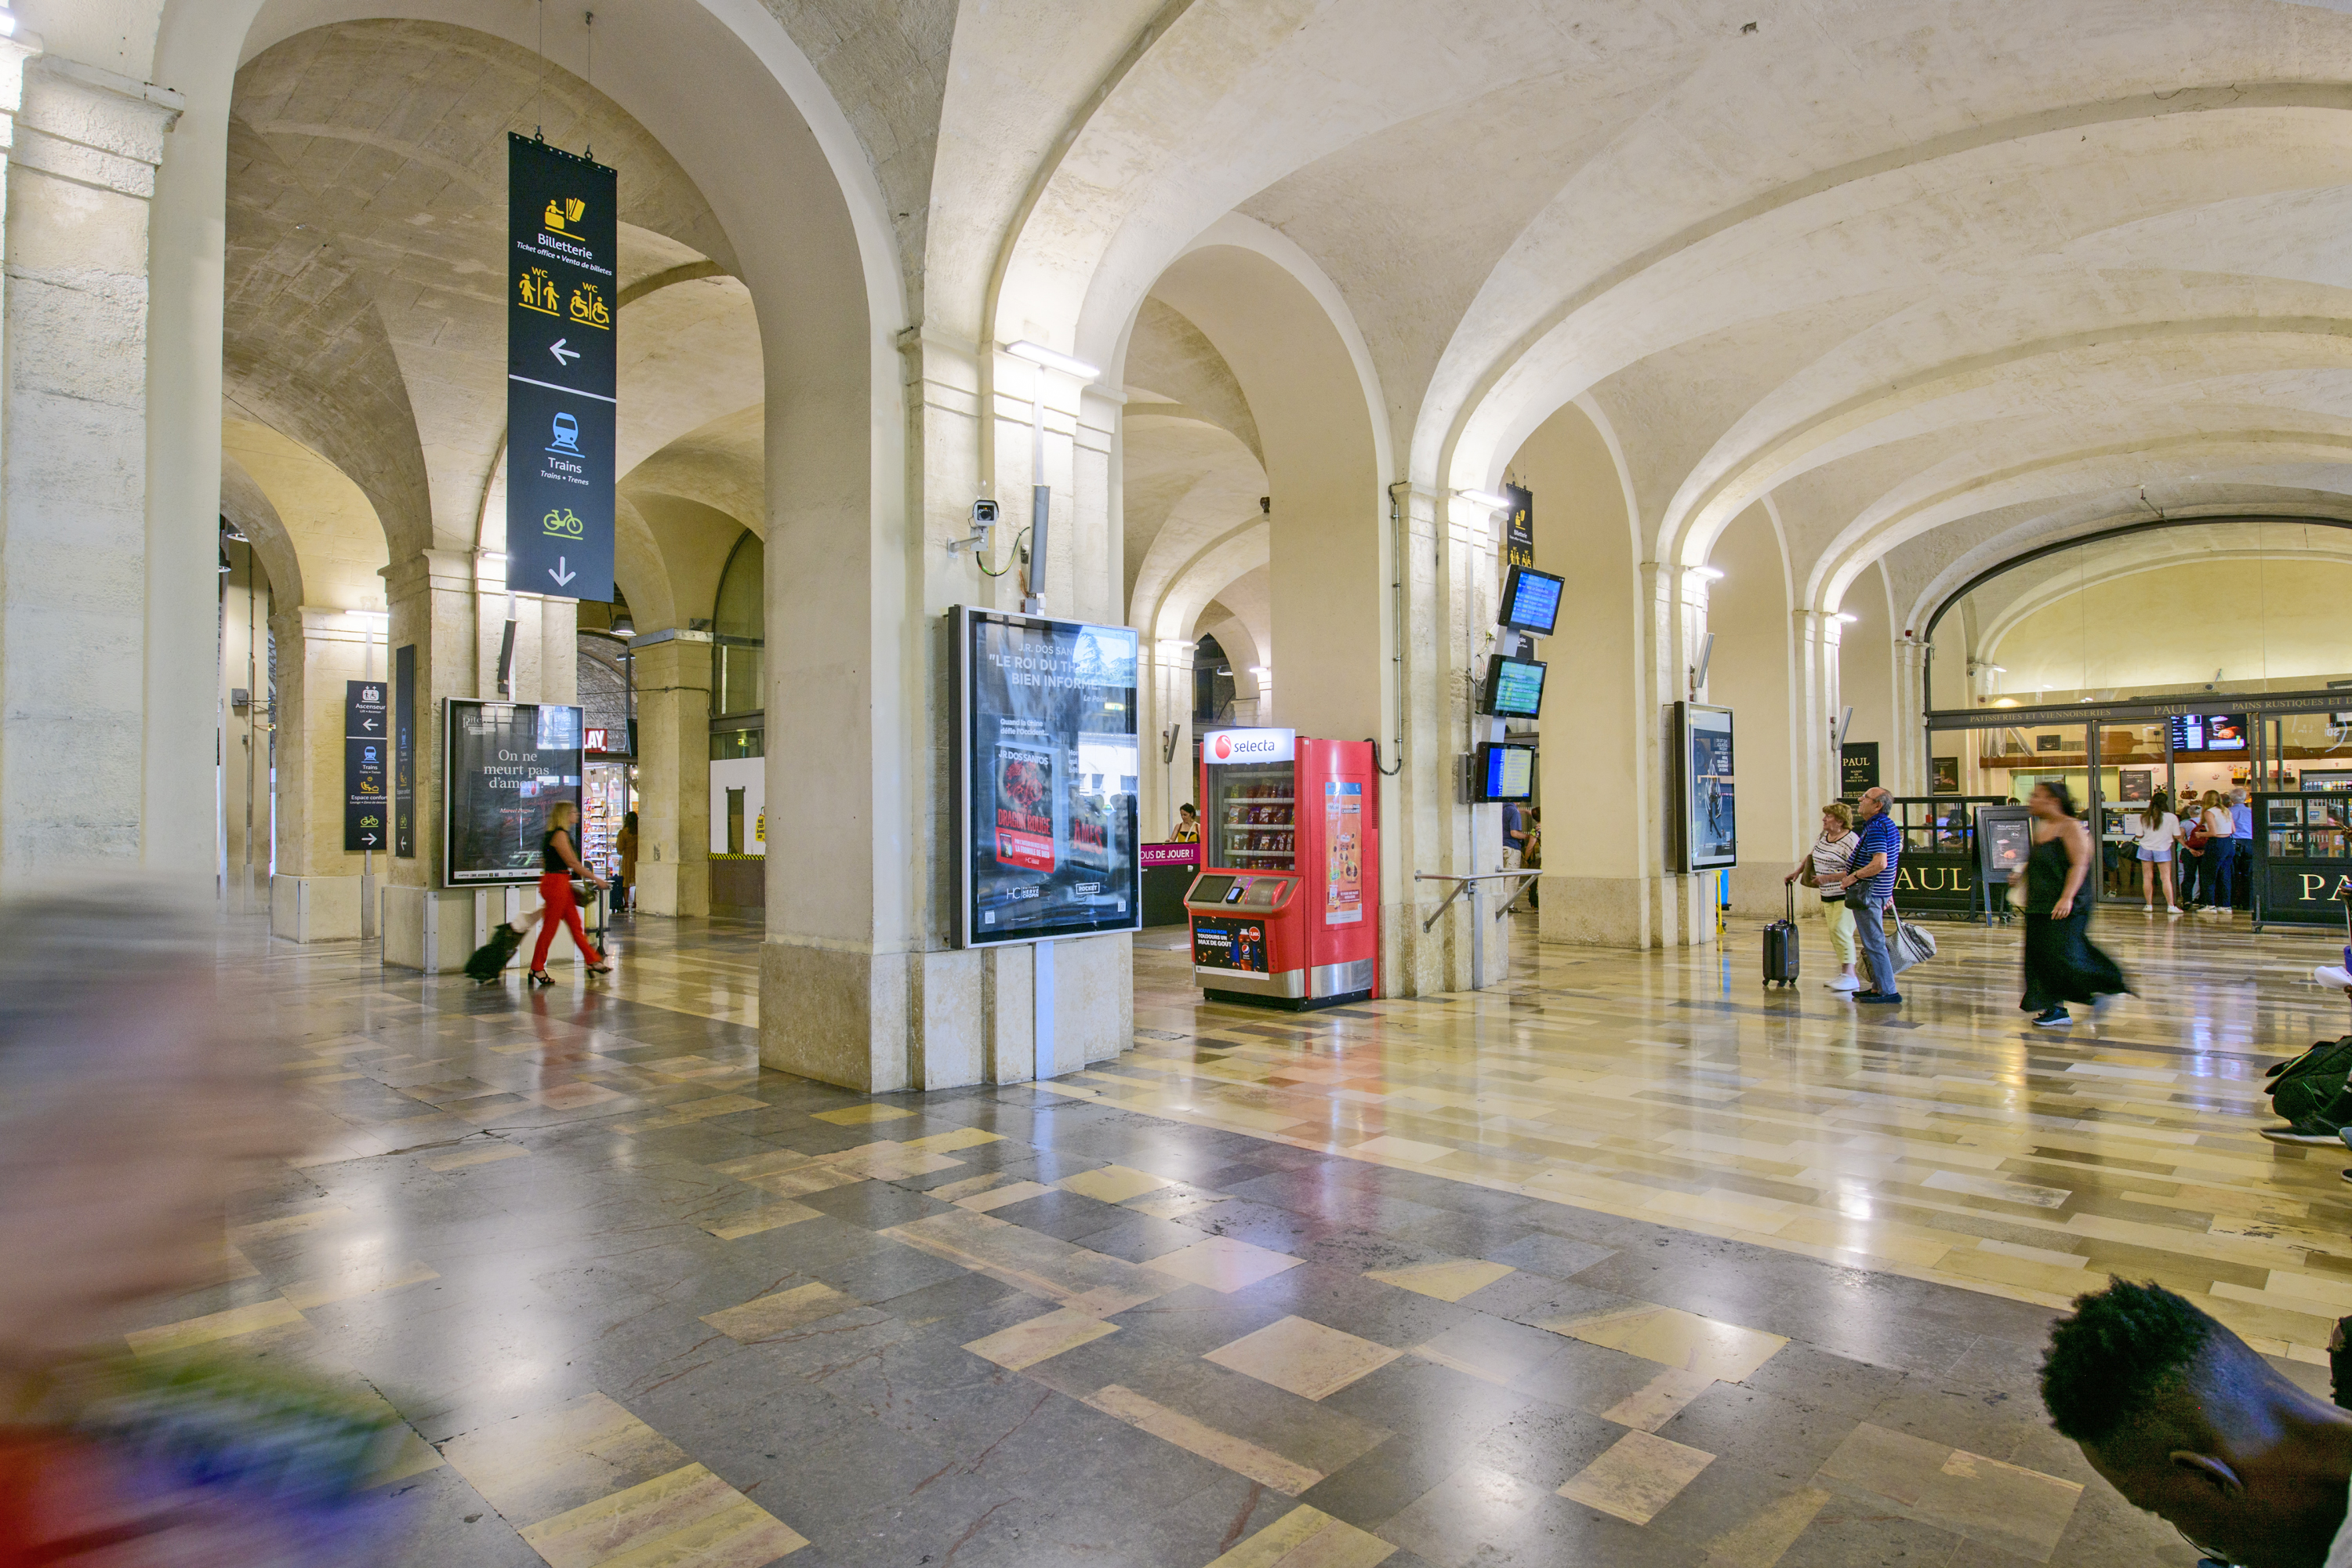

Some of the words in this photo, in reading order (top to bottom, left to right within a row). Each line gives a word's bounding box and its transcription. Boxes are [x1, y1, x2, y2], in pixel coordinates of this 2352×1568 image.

[538, 233, 593, 260] Billetterie
[517, 241, 536, 253] Ticket
[537, 249, 556, 259] office
[561, 255, 580, 267] Venta
[581, 260, 590, 269] de
[590, 263, 612, 276] billetes
[532, 267, 548, 278] WC
[583, 281, 598, 293] WC
[548, 456, 583, 474] Trains
[540, 470, 561, 481] Trains
[568, 475, 589, 486] Trenes
[1018, 643, 1033, 652] J.R.
[1036, 644, 1054, 655] DOS
[1014, 656, 1036, 670] ROI
[1040, 659, 1057, 671] DU
[1011, 673, 1040, 686] BIEN
[2154, 704, 2192, 715] PAUL
[2232, 702, 2262, 710] PAINS
[2266, 698, 2324, 708] RUSTIQUES
[1970, 713, 2022, 722] PATISSERIES
[2040, 709, 2111, 719] VIENNOISERIES
[1233, 739, 1276, 753] selecta
[498, 749, 518, 762] On
[522, 753, 538, 762] ne
[1008, 751, 1022, 762] DOS
[1023, 753, 1049, 765] SANTOS
[1842, 757, 1871, 767] PAUL
[484, 764, 524, 775] meurt
[528, 767, 549, 778] pas
[997, 808, 1025, 830] DRAGON
[1027, 814, 1051, 835] ROUGE
[1073, 818, 1103, 855] ÂMES
[1020, 846, 1036, 856] FORMULE
[1036, 848, 1041, 857] DE
[1041, 850, 1050, 858] DIEU
[1140, 851, 1154, 859] OUS
[1156, 850, 1165, 858] DE
[1893, 866, 1971, 891] AUL
[1007, 887, 1021, 900] HC
[2299, 873, 2351, 901] PA
